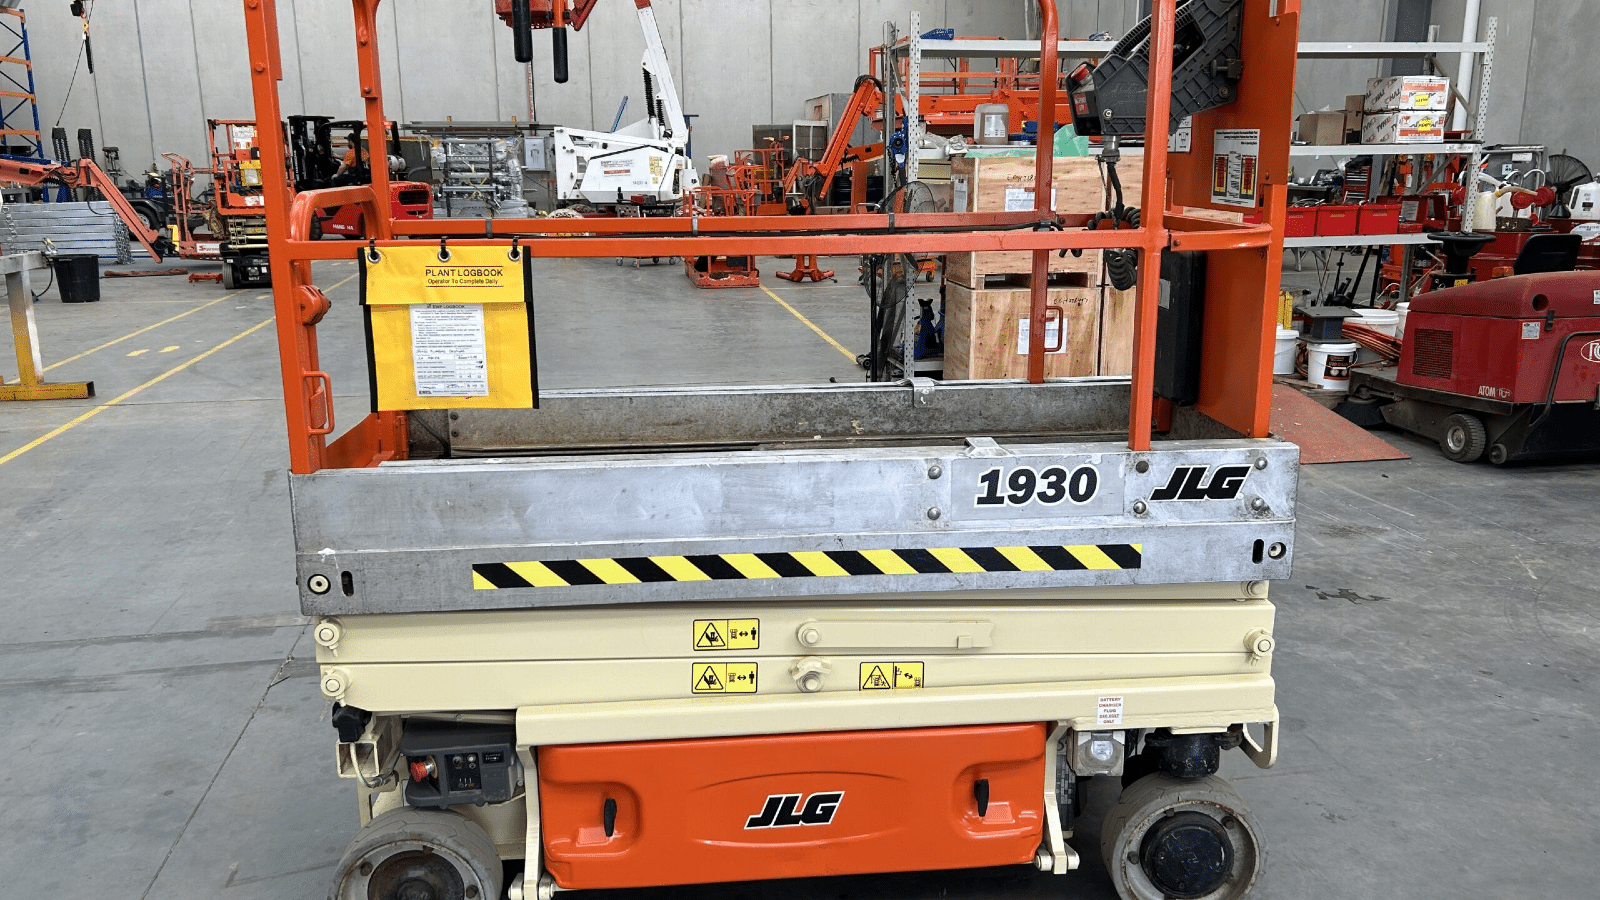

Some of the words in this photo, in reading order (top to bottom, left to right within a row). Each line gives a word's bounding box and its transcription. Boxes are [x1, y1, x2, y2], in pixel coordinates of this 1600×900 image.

[1478, 386, 1496, 397] ATOM
[975, 466, 1098, 506] 1930
[1150, 464, 1252, 501] JLG
[744, 791, 845, 830] JLG
